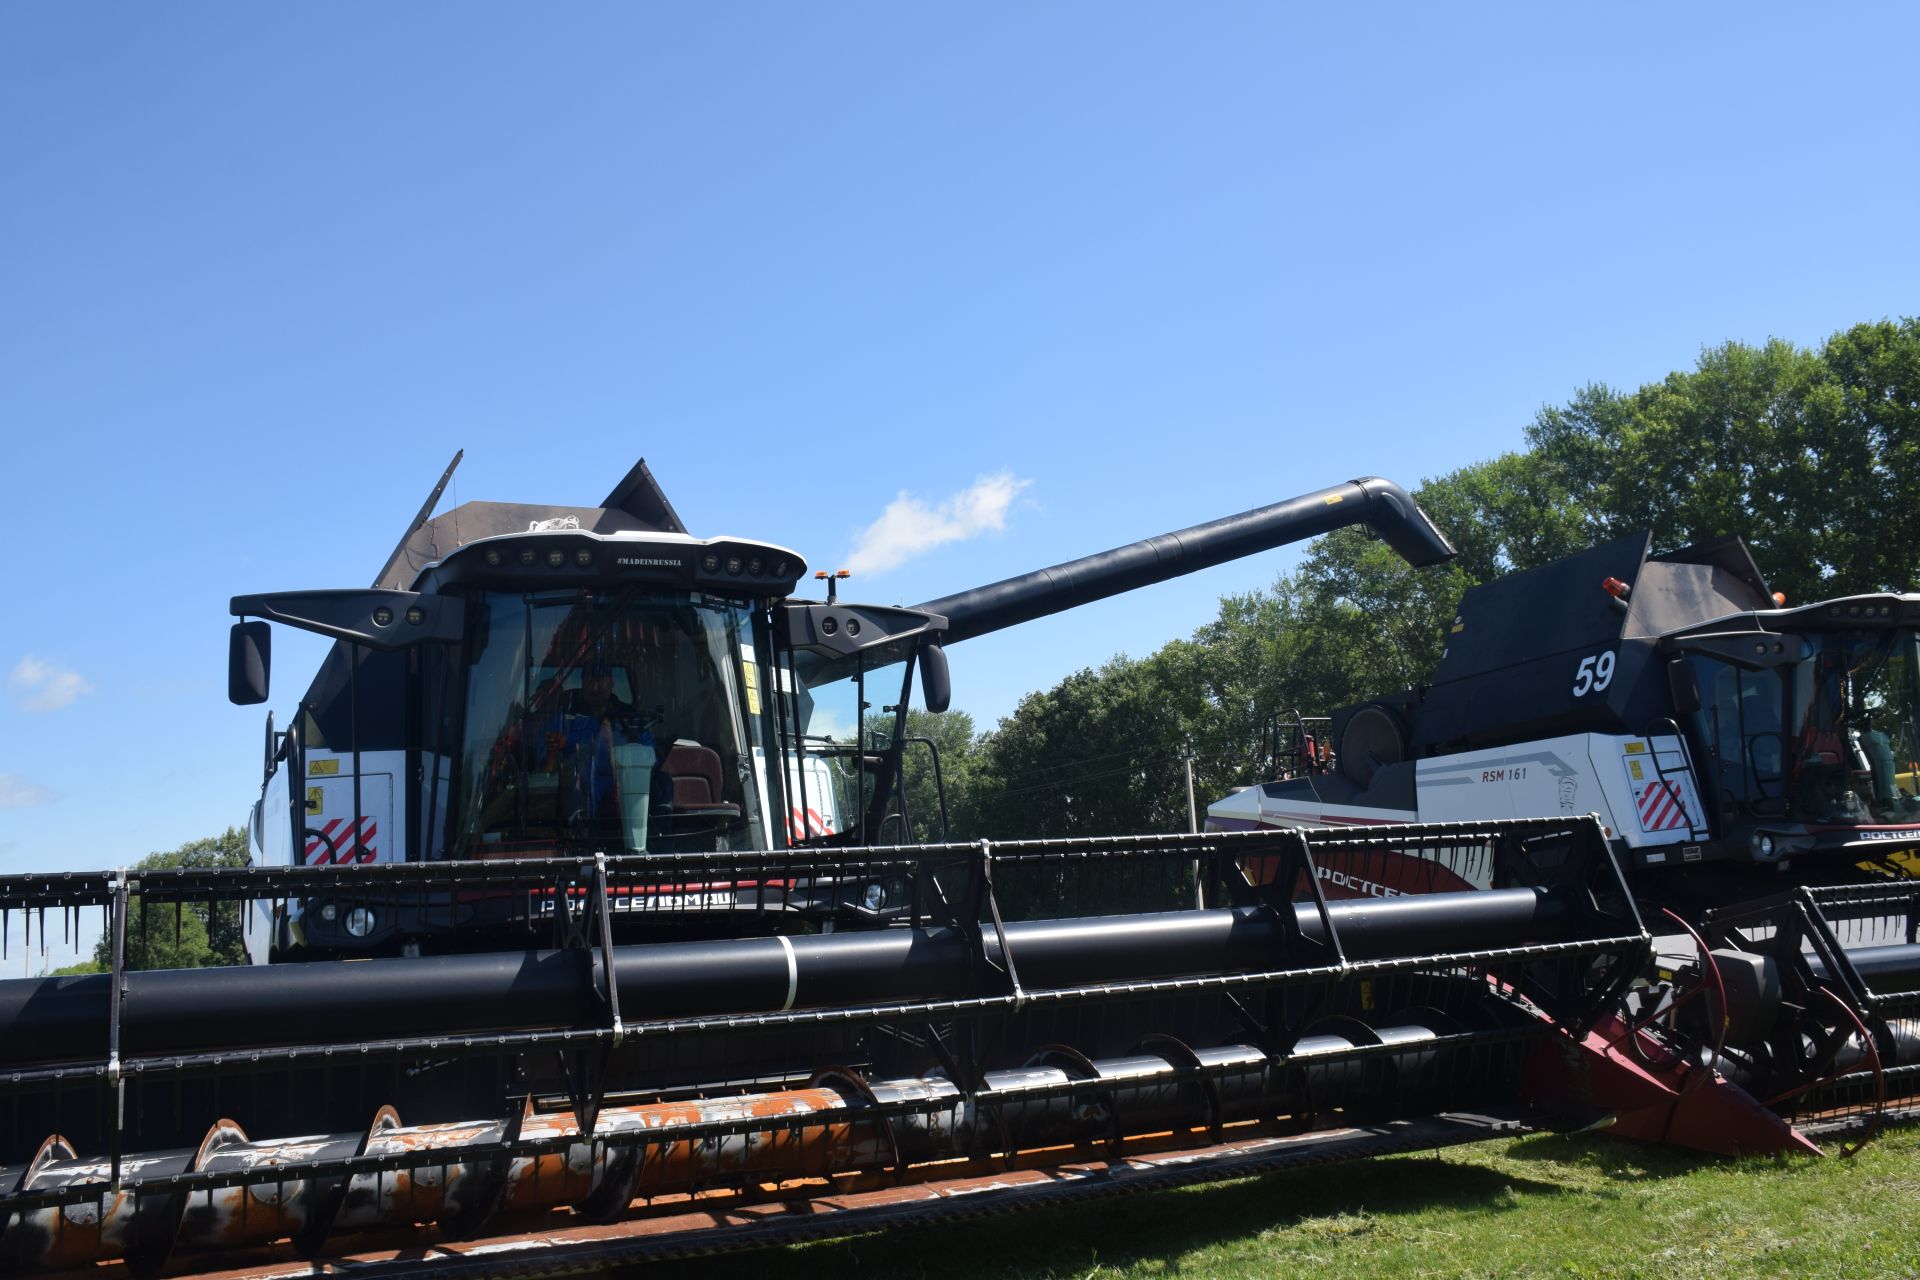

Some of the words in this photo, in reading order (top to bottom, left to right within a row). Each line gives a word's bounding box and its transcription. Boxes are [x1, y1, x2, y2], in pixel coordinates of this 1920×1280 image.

[617, 557, 682, 567] #MADEINRUSSIA
[1573, 650, 1616, 697] 59
[1482, 769, 1505, 783] RSM
[1508, 767, 1527, 781] 161
